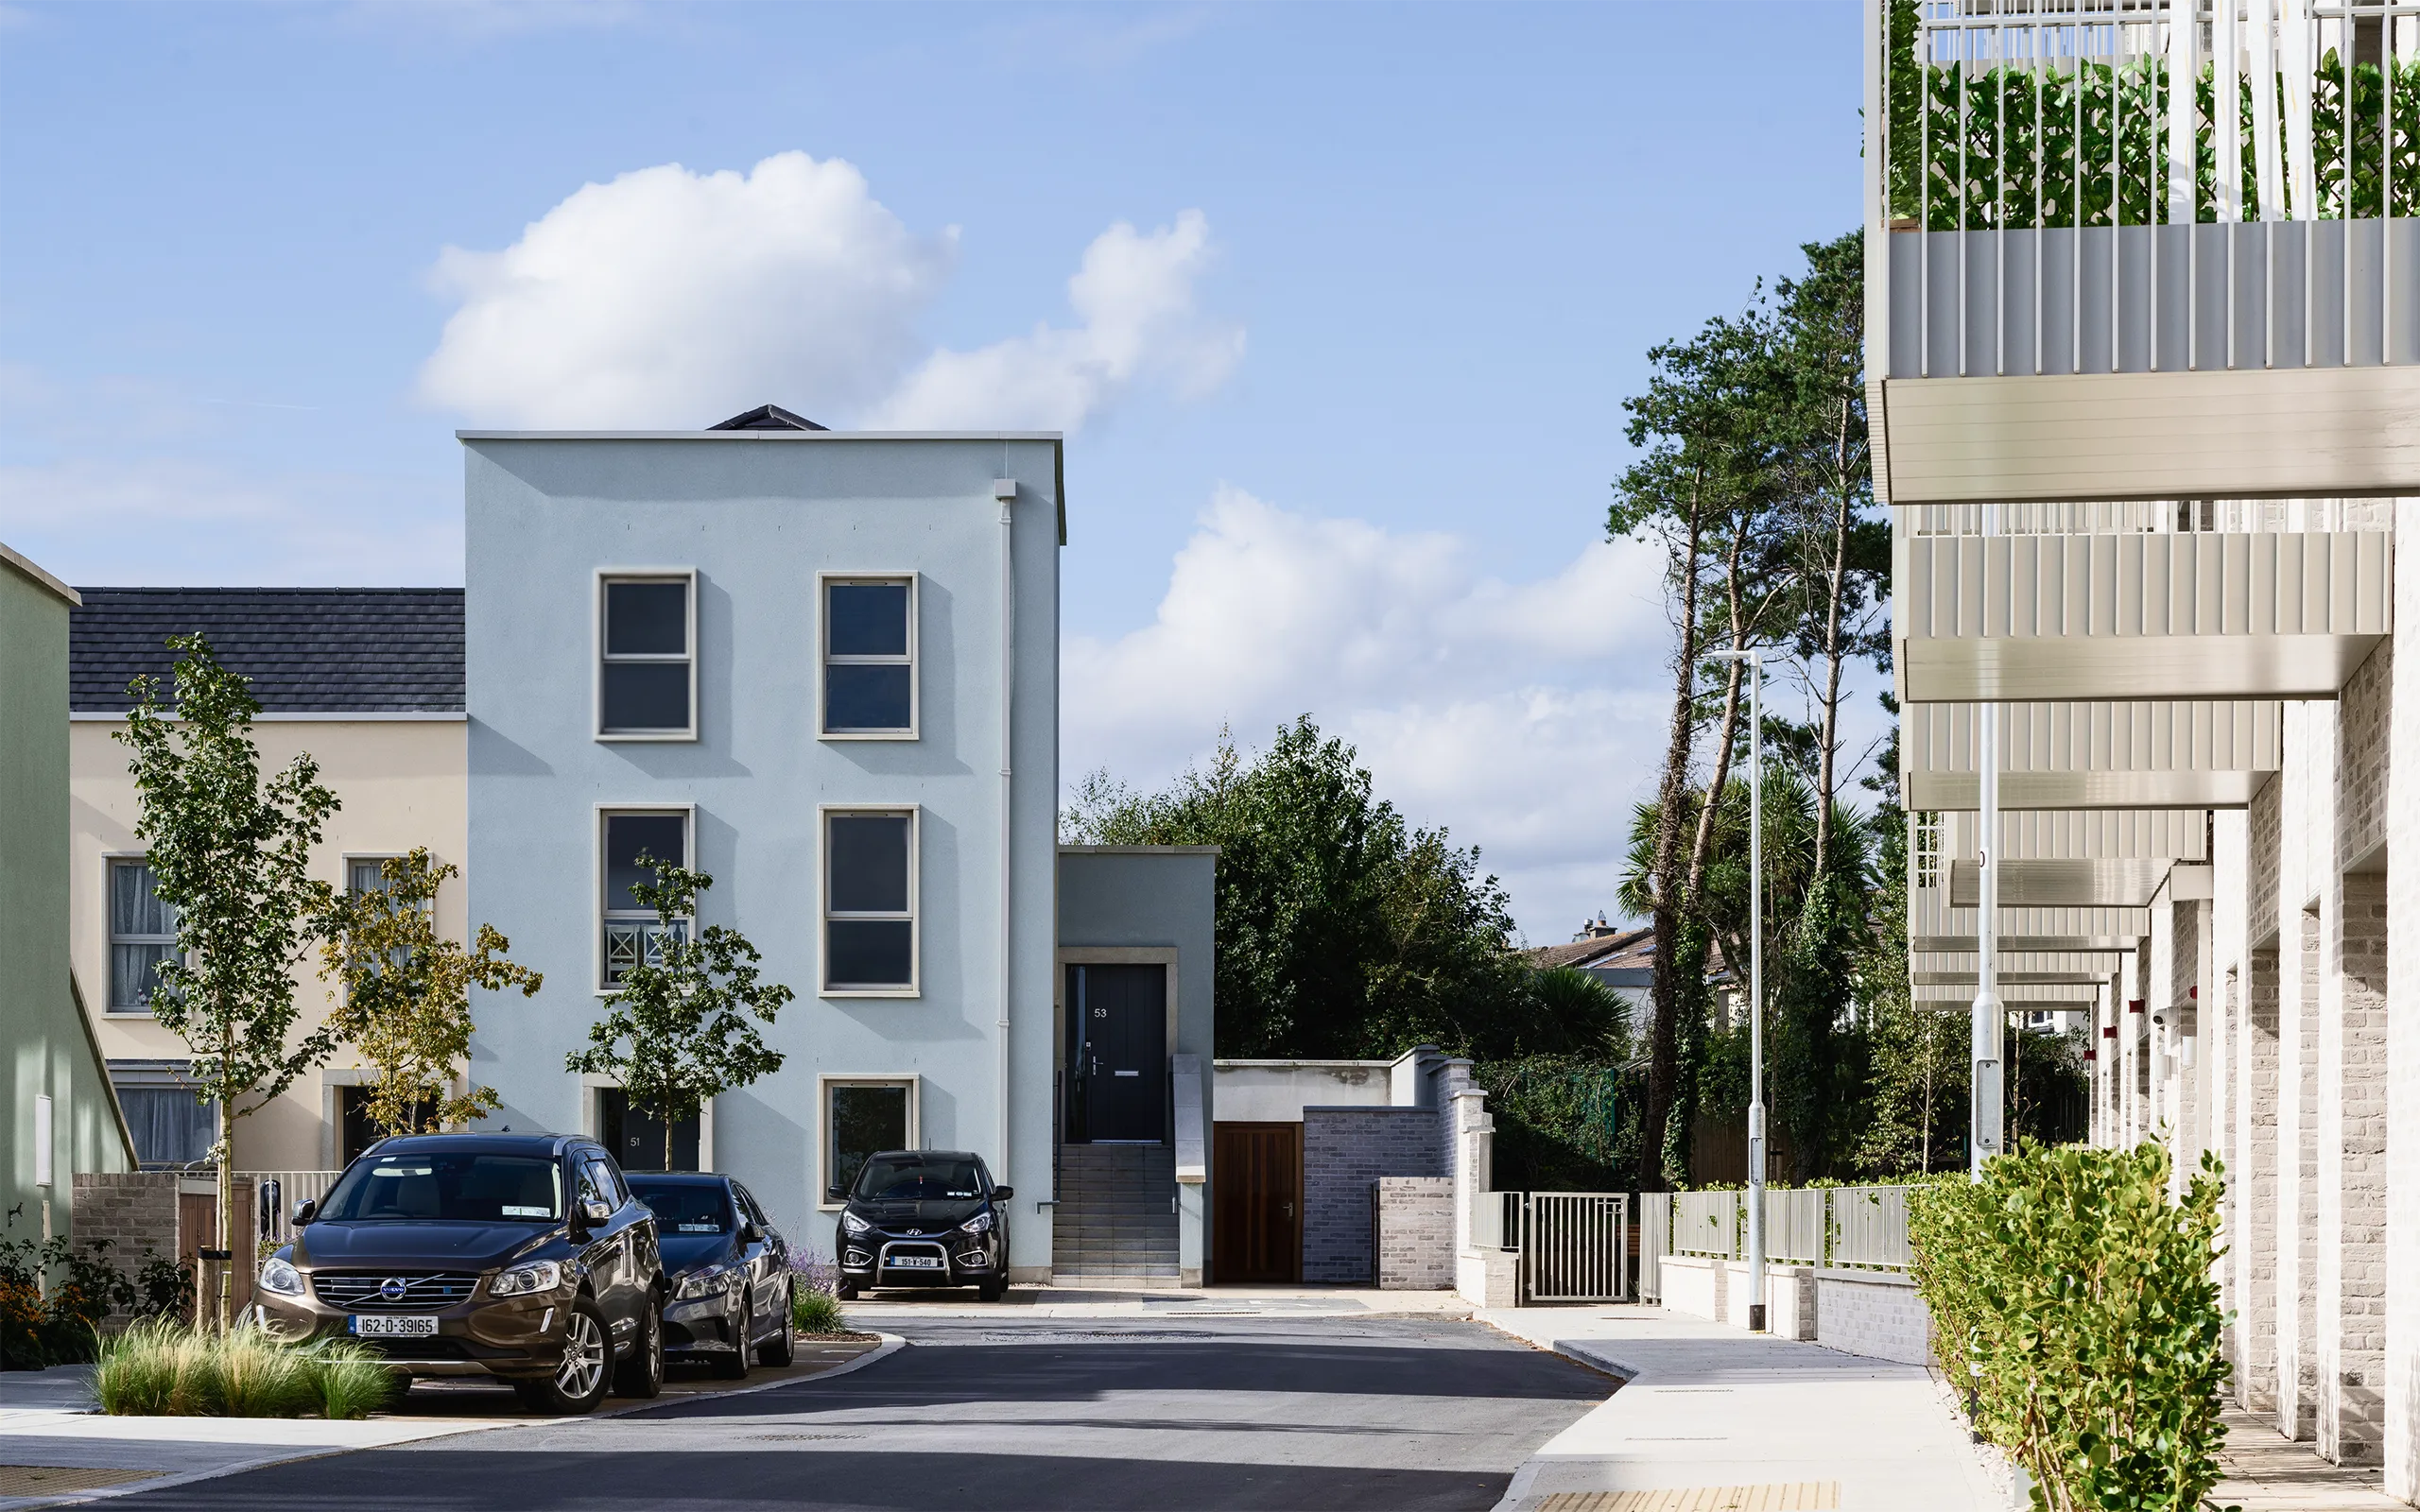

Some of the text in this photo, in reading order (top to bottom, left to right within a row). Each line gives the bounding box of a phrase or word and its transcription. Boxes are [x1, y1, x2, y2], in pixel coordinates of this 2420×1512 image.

[1094, 1008, 1107, 1018] 53
[630, 1137, 640, 1146] 51
[362, 1319, 433, 1332] 162-D-39165
